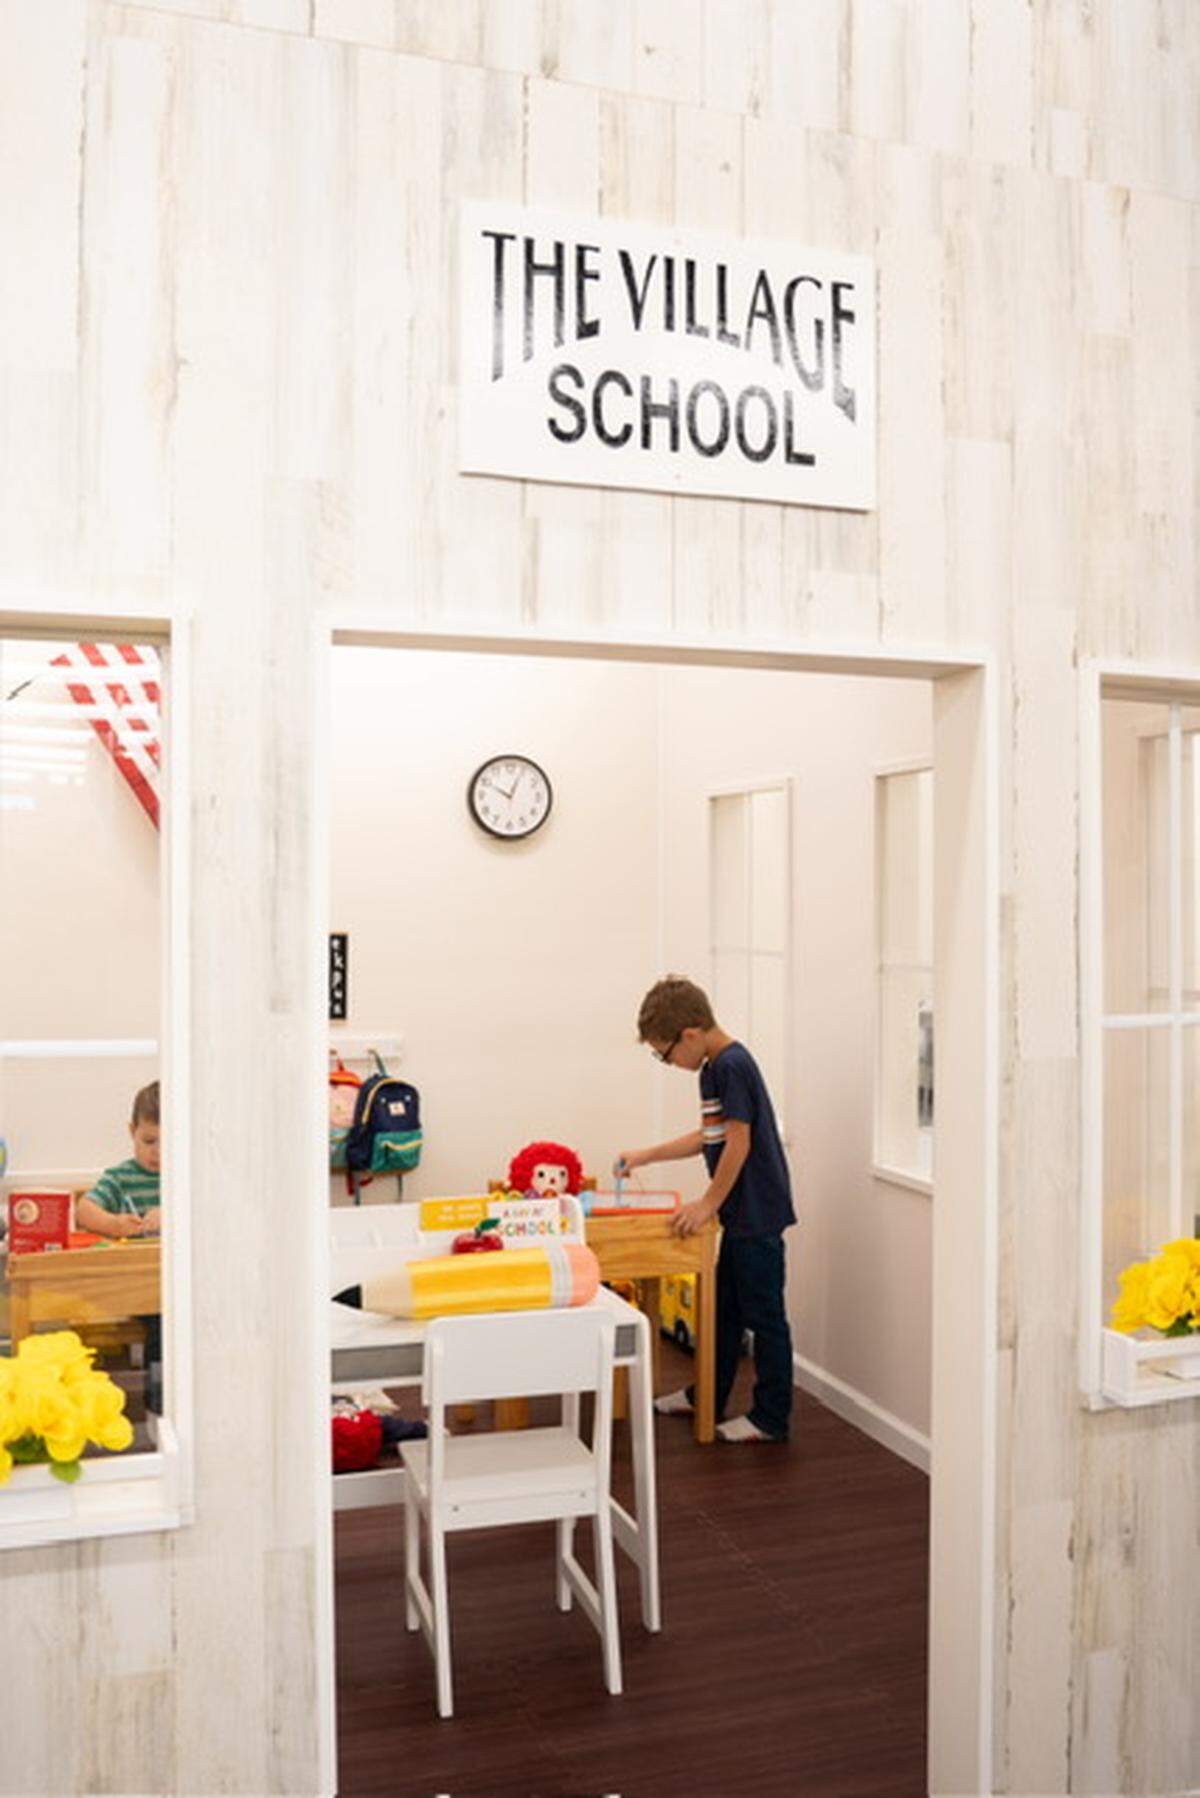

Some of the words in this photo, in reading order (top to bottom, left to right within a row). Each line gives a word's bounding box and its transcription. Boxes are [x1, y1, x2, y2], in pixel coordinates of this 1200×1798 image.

[481, 230, 601, 383] THE
[617, 249, 857, 424] VILLAGE
[546, 363, 816, 467] SCHOOL
